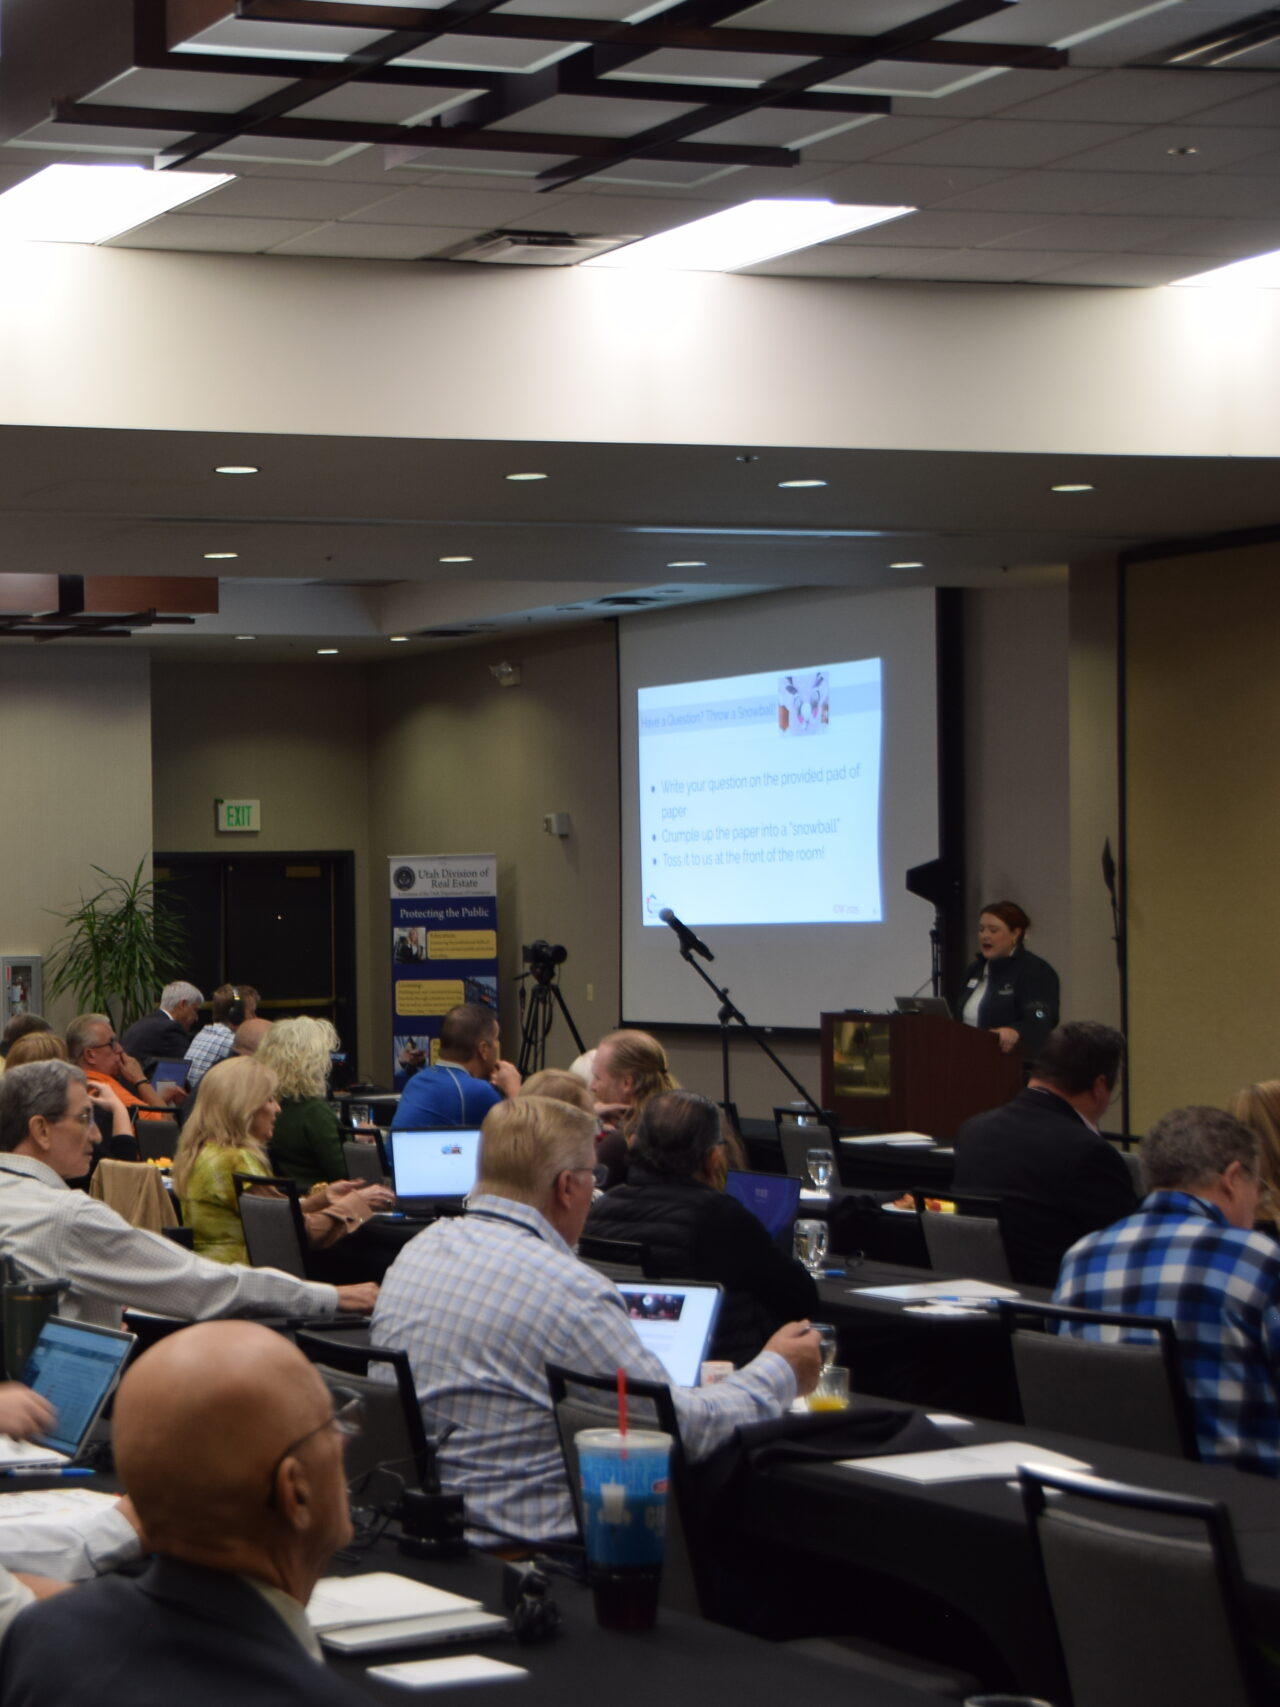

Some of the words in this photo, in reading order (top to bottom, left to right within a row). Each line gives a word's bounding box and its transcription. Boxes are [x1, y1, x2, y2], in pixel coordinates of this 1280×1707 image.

[661, 777, 685, 793] Write
[686, 779, 706, 796] your
[708, 774, 747, 794] question
[749, 774, 761, 788] on
[763, 771, 779, 787] the
[781, 767, 823, 788] provided
[826, 764, 846, 784] pad
[849, 762, 861, 779] of
[226, 805, 252, 827] EXIT
[661, 805, 687, 821] paper
[661, 828, 699, 845] Crumple
[702, 829, 713, 844] up
[715, 825, 730, 840] the
[732, 826, 759, 843] paper
[761, 823, 779, 837] into
[663, 852, 682, 867] Toss
[683, 852, 690, 866] it
[691, 852, 700, 866] to
[702, 852, 713, 866] us
[714, 850, 724, 865] at
[725, 849, 740, 864] the
[742, 848, 764, 863] front
[766, 846, 776, 863] of
[778, 847, 794, 862] the
[796, 845, 825, 861] room!
[418, 868, 440, 880] Utah
[441, 868, 478, 879] Division
[479, 866, 490, 878] of
[431, 879, 450, 889] Real
[452, 878, 479, 888] Estate
[400, 907, 445, 921] Protecting
[445, 907, 459, 918] the
[461, 906, 490, 918] Public
